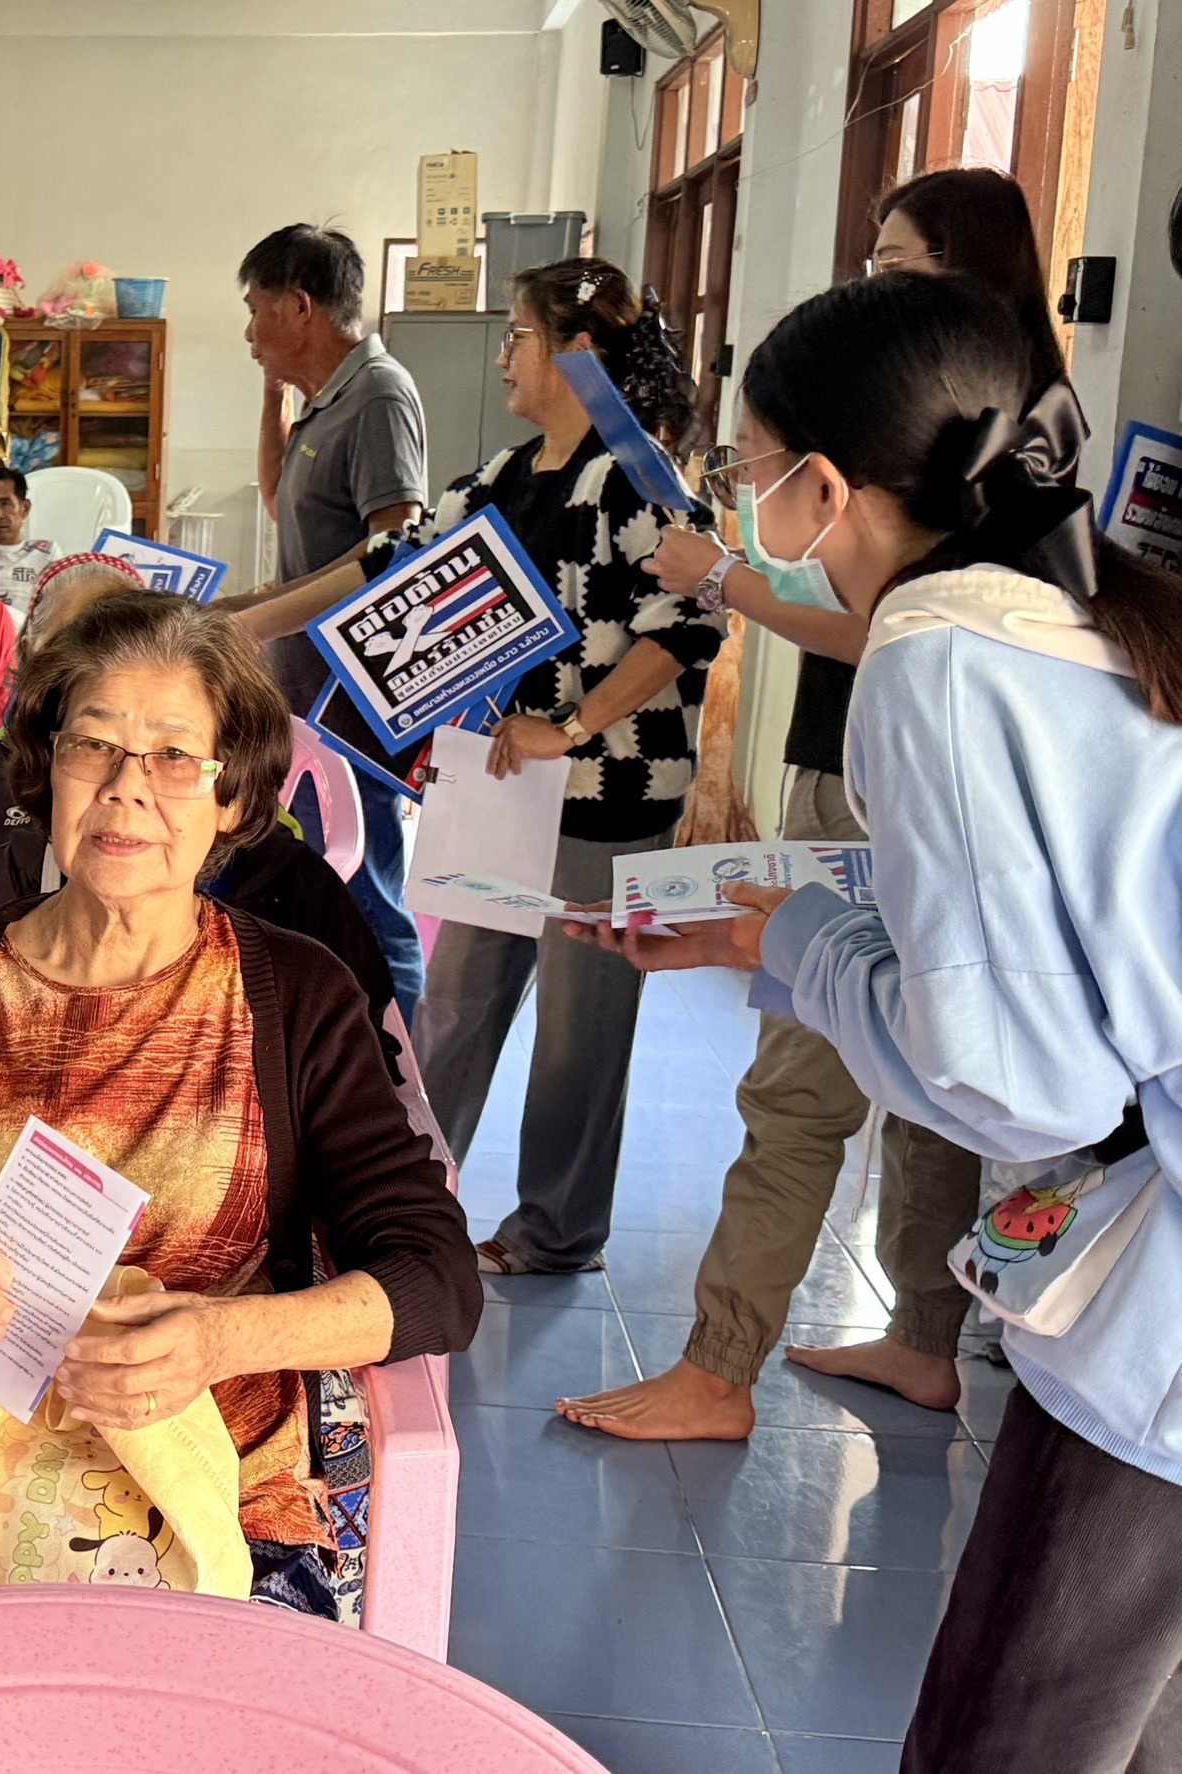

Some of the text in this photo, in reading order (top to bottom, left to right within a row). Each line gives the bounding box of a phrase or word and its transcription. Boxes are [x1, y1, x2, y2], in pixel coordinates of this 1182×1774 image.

[417, 261, 461, 276] FRESH
[348, 547, 481, 643] ต่อต้าน
[25, 1441, 69, 1505] DAY
